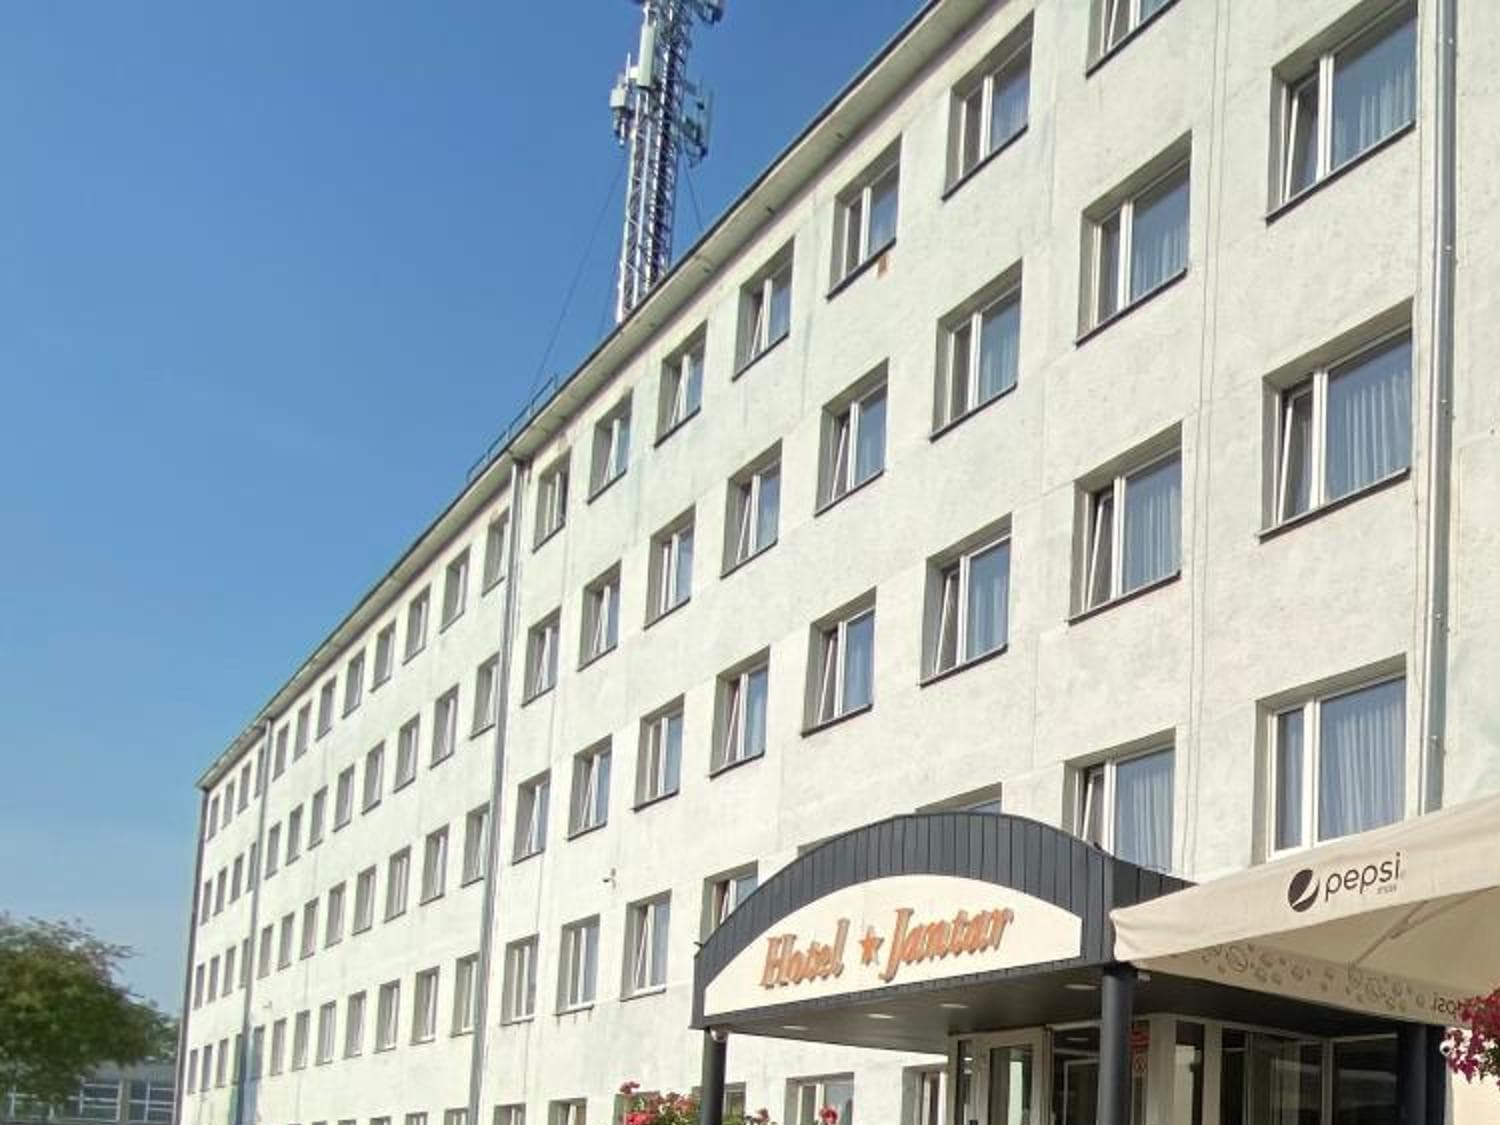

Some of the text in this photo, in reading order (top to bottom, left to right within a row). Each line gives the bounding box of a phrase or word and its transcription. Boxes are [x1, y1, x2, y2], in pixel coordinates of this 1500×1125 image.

[1325, 852, 1401, 902] pepsi
[759, 907, 1015, 990] Hotel Jantar
